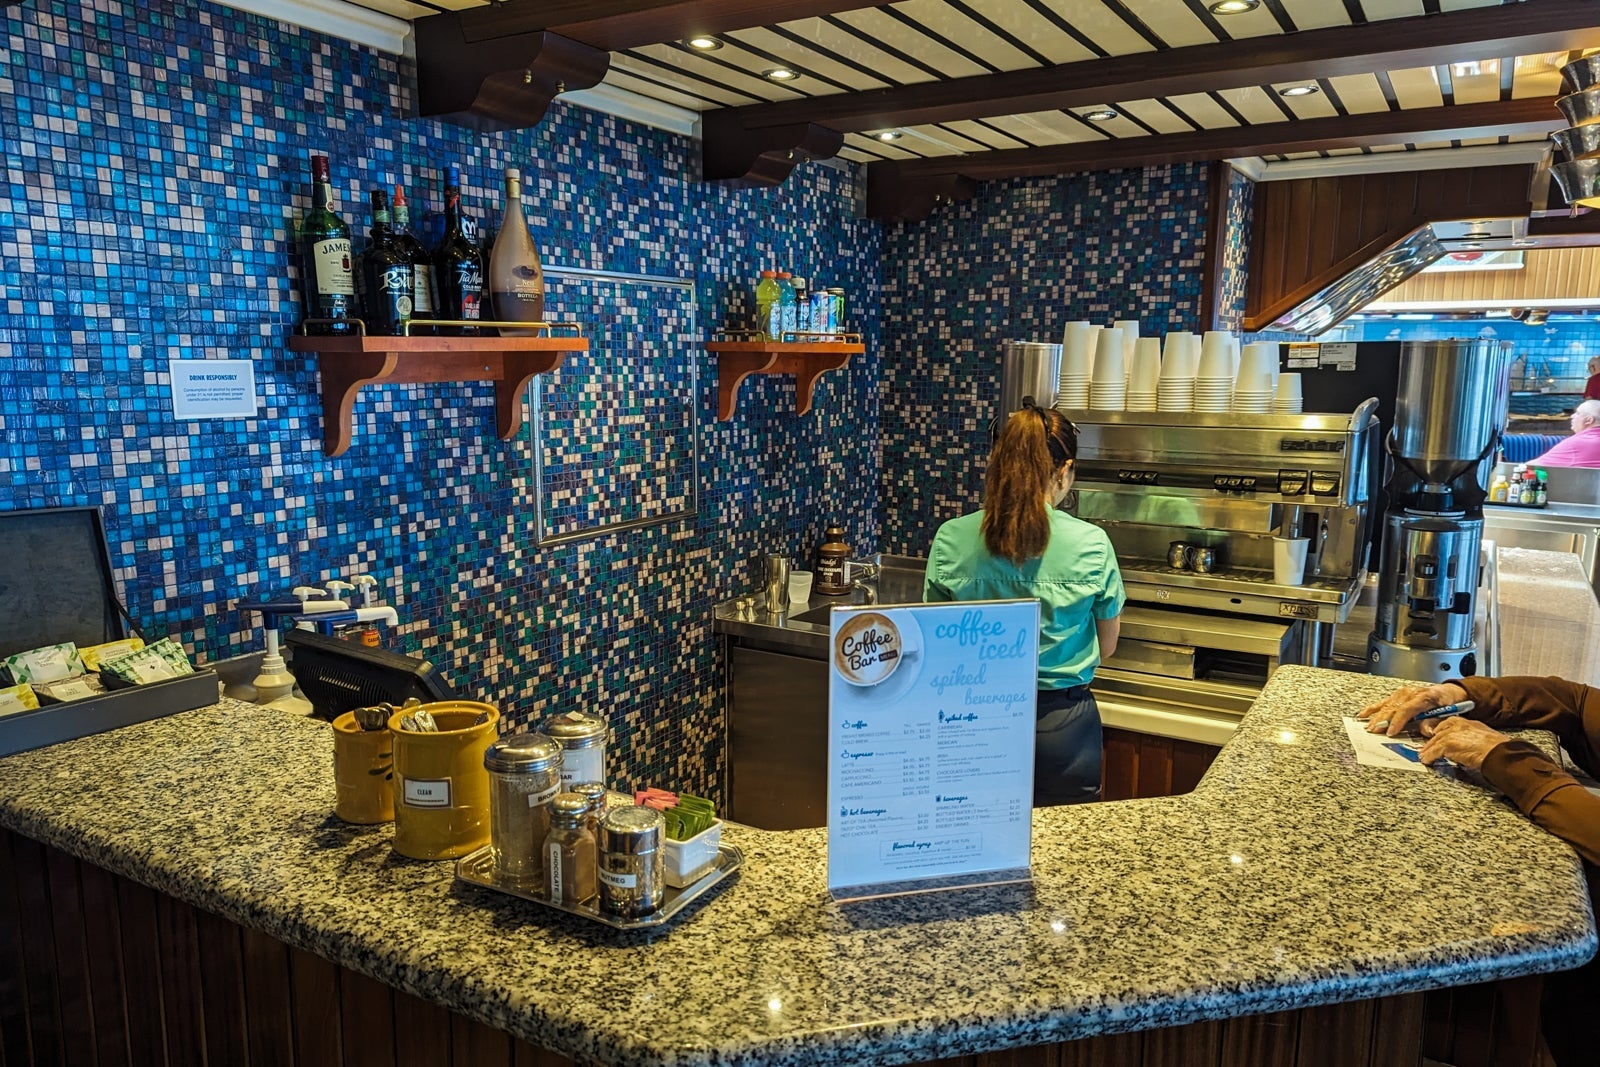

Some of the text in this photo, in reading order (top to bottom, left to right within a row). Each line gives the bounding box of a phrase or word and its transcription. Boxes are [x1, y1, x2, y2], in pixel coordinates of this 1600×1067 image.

[936, 610, 1006, 646] coffee
[842, 629, 893, 656] Coffee
[978, 628, 1026, 660] iced
[848, 654, 877, 671] Bar
[930, 664, 986, 696] spiked
[964, 688, 1028, 710] beverages
[851, 720, 868, 730] coffee
[945, 713, 962, 724] spiked
[962, 712, 978, 722] coffee
[850, 752, 874, 760] espresso
[942, 795, 968, 804] beverages
[860, 808, 888, 816] beverages
[552, 850, 560, 892] CHOCOLATE
[601, 872, 626, 884] NUTMEG
